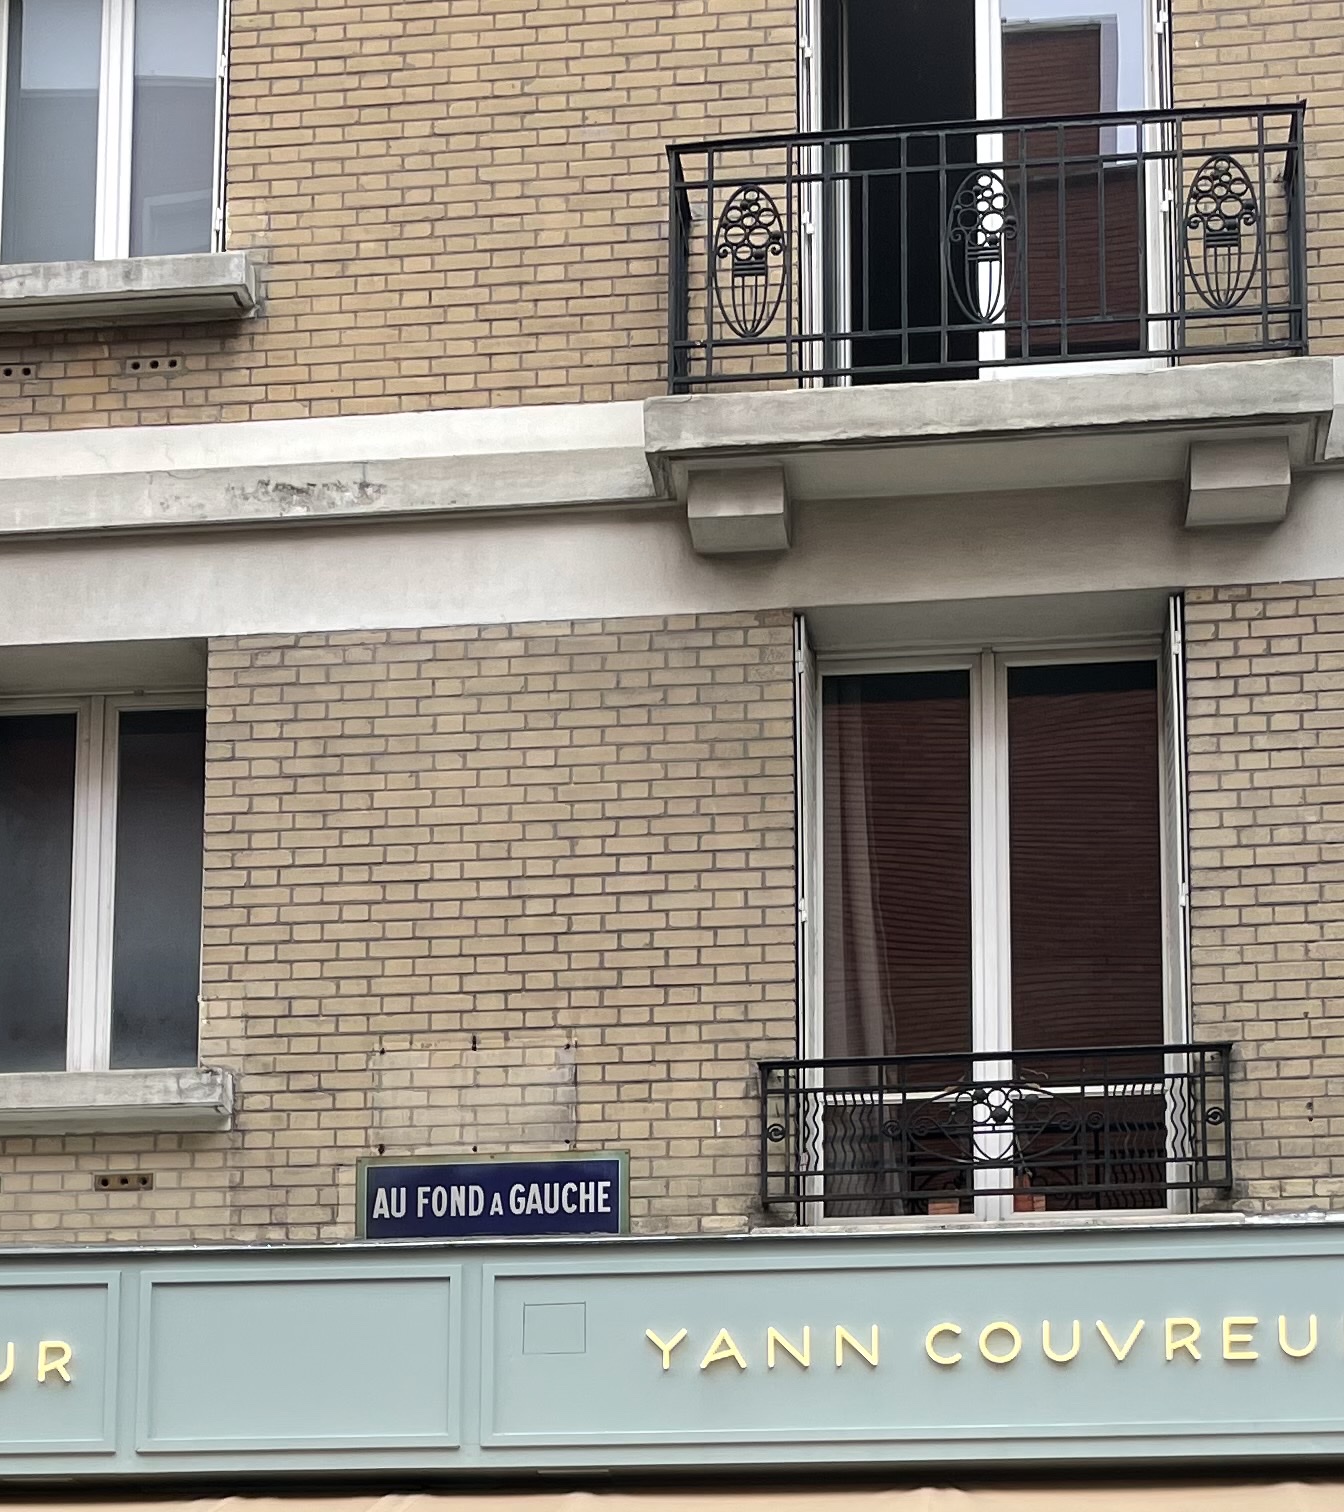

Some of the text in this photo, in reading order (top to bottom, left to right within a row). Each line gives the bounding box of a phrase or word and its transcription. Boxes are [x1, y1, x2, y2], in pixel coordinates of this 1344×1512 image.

[372, 1181, 612, 1219] AU FOND A GAUCHE
[645, 1324, 881, 1370] YANN
